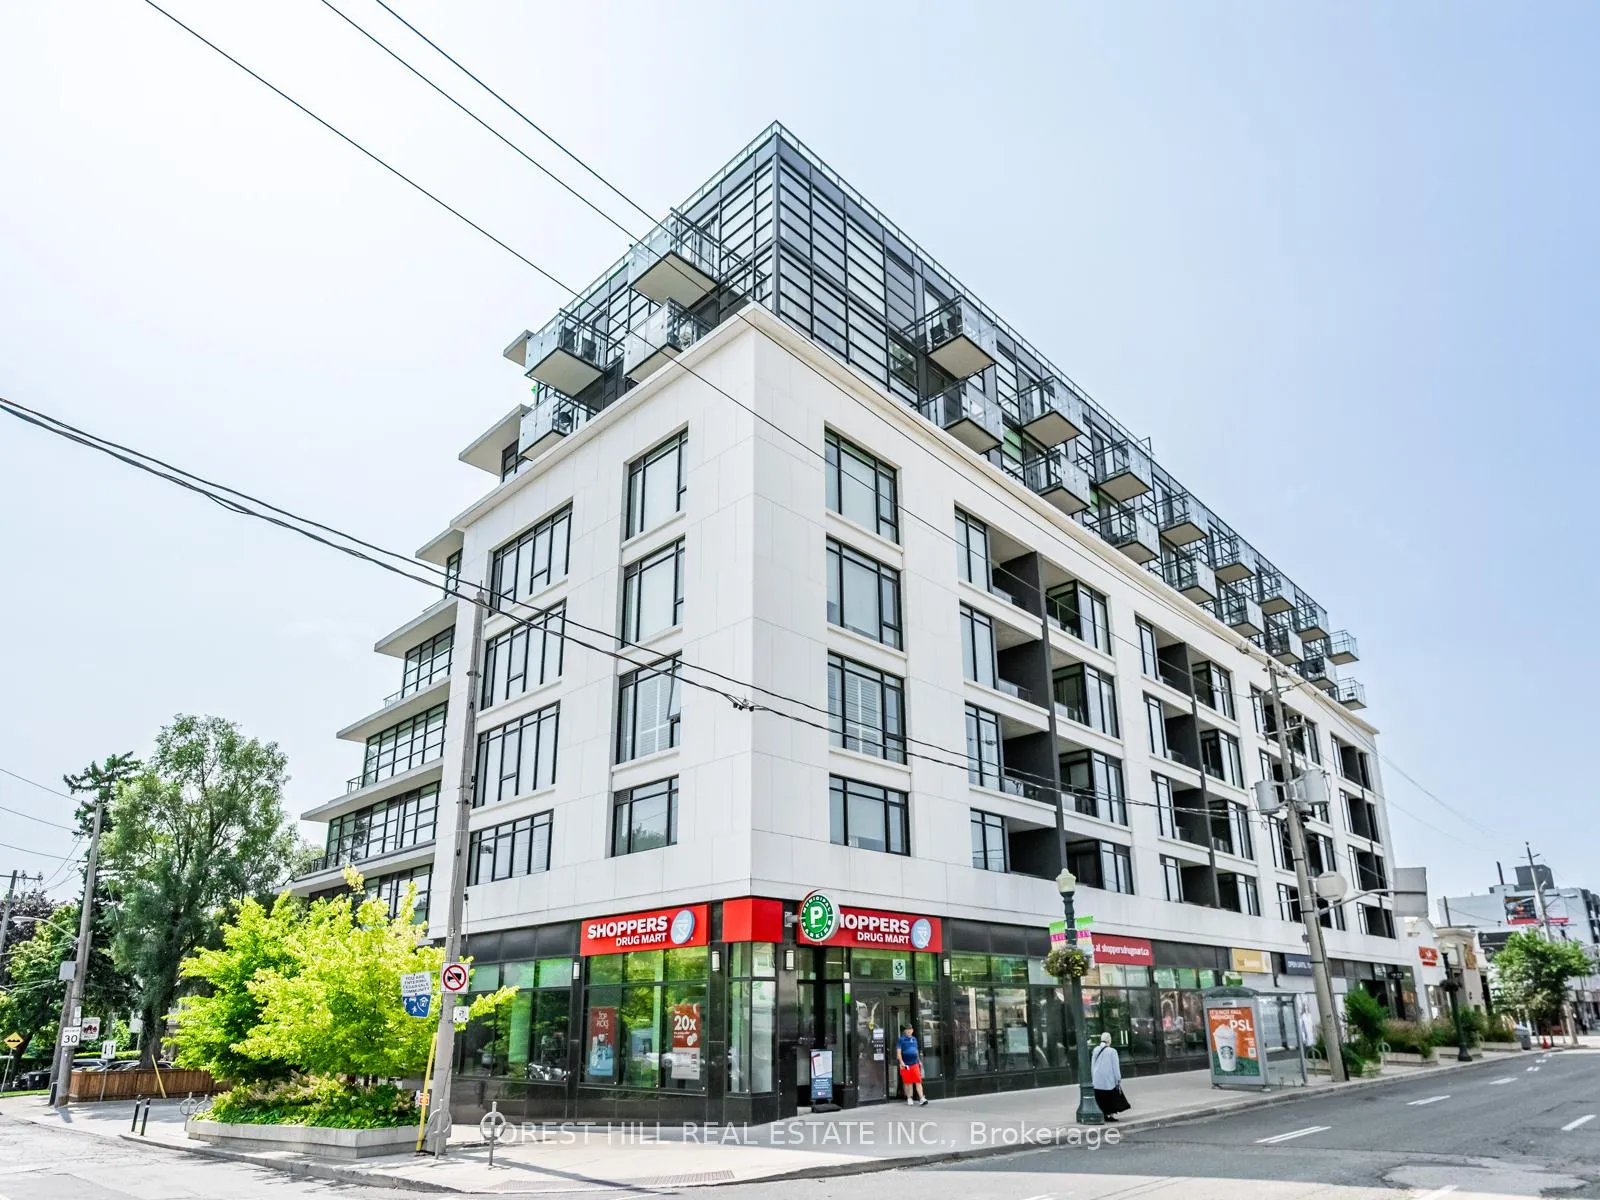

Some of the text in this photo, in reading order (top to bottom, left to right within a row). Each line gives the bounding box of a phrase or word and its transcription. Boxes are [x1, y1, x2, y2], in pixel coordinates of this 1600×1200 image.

[810, 906, 823, 926] P
[840, 913, 910, 934] OPPERS
[587, 915, 668, 940] SHOPPERS
[616, 932, 667, 947] DRUG MART
[857, 931, 910, 945] DRUG MART
[673, 1014, 697, 1031] 20x
[1229, 1019, 1253, 1032] PSL
[63, 1034, 78, 1044] 30
